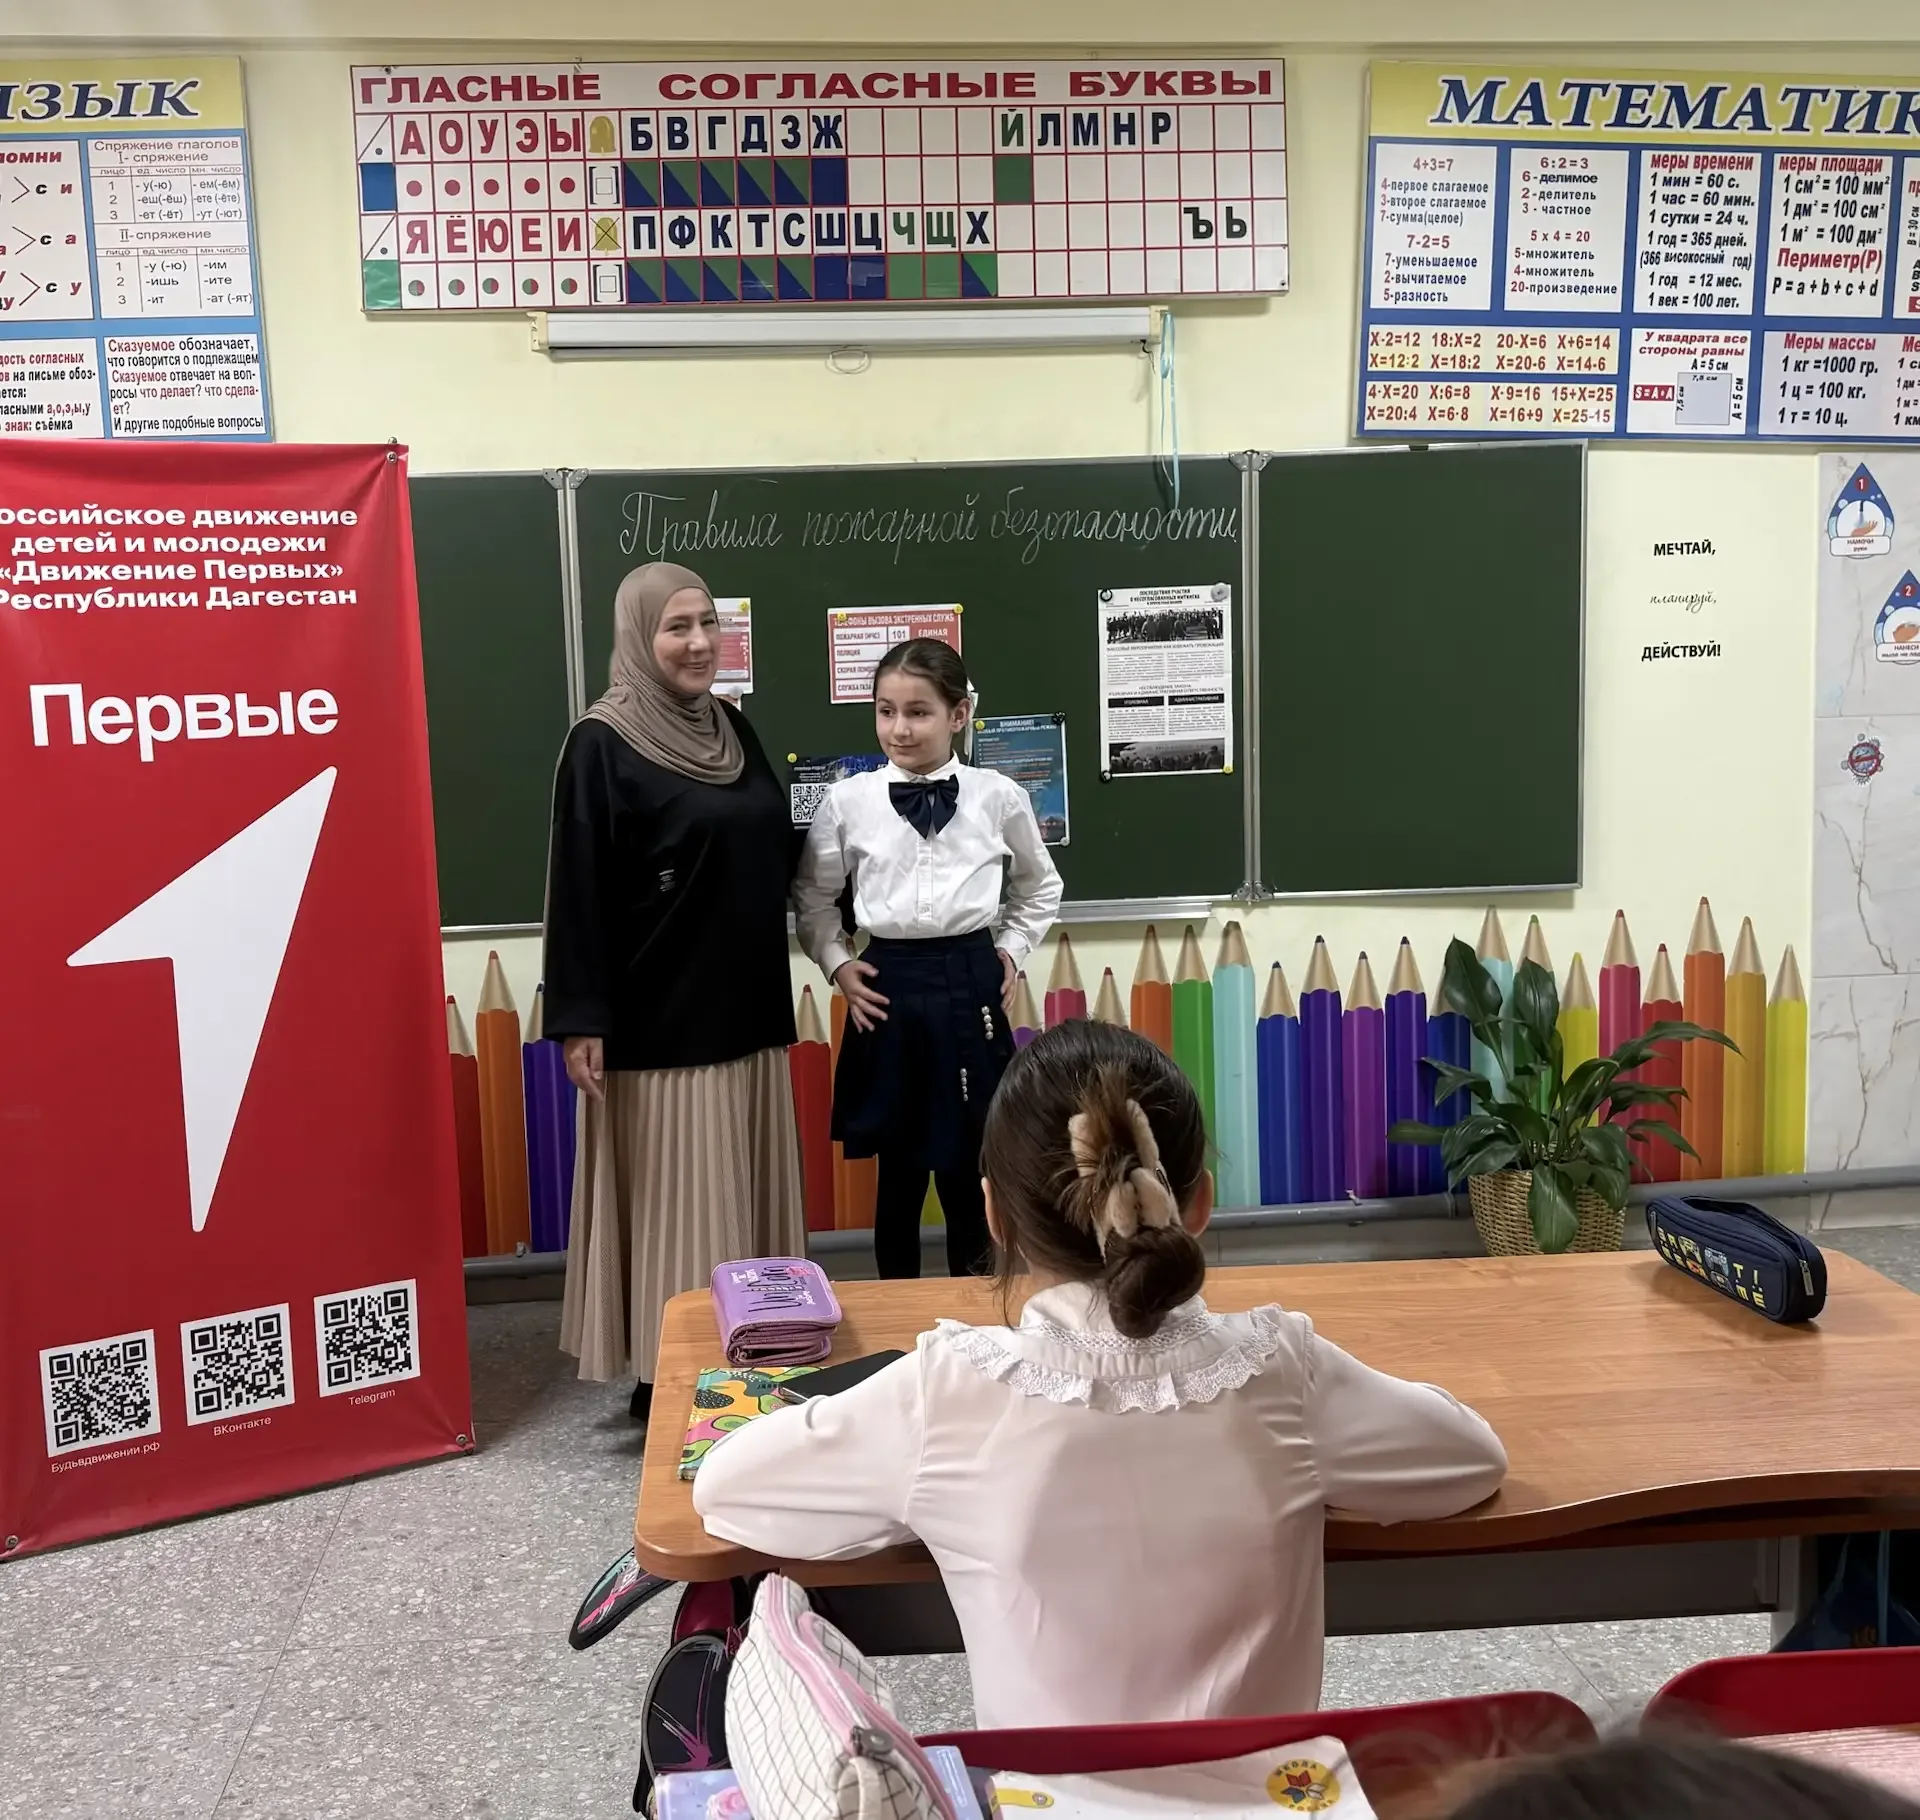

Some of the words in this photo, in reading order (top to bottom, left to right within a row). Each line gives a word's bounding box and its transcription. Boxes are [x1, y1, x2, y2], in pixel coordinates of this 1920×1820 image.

[360, 73, 600, 105] ГЛАСНЫЕ
[658, 72, 1037, 100] СОГЛАСНЫЕ
[1069, 70, 1273, 98] БУКВЫ
[400, 120, 426, 155] А
[438, 119, 463, 155] О
[479, 118, 499, 155] У
[516, 118, 539, 153] Э
[549, 117, 581, 153] Ы
[630, 117, 653, 151] Б
[667, 116, 690, 151] В
[707, 115, 727, 150] Г
[741, 115, 768, 153] Д
[780, 115, 801, 150] З
[812, 114, 843, 150] Ж
[1037, 112, 1061, 146] Л
[1072, 112, 1100, 146] М
[1113, 112, 1137, 146] Н
[1152, 111, 1172, 145] Р
[94, 141, 173, 153] Спряжение
[178, 140, 239, 150] глаголов
[133, 153, 209, 166] спряжение
[1413, 158, 1454, 172] 4+3=7
[1651, 154, 1688, 172] меры
[1693, 154, 1754, 173] времени
[1779, 155, 1816, 175] меры
[1820, 156, 1883, 174] площади
[1432, 181, 1489, 194] слагаемое
[1430, 197, 1487, 210] слагаемое
[1542, 205, 1592, 215] частное
[1660, 212, 1700, 228] сутки
[136, 231, 212, 242] спряжение
[406, 219, 428, 255] Я
[478, 218, 509, 252] Ю
[521, 218, 541, 252] Е
[558, 217, 581, 252] И
[633, 216, 656, 251] П
[668, 215, 696, 250] Ф
[711, 214, 732, 249] К
[748, 214, 769, 249] Т
[783, 213, 805, 248] С
[814, 212, 846, 247] Ш
[854, 212, 882, 251] Ц
[892, 211, 915, 246] Ч
[926, 211, 956, 248] Щ
[966, 211, 990, 245] Х
[1183, 207, 1214, 239] Ъ
[1226, 206, 1247, 239] Ь
[1407, 235, 1450, 249] 7-2=5
[1664, 250, 1725, 265] високосный
[108, 339, 175, 355] Сказуемое
[179, 337, 254, 351] обозначает,
[1658, 334, 1719, 345] квадрата
[1724, 335, 1748, 344] все
[1784, 333, 1824, 353] Меры
[1828, 337, 1876, 351] массы
[29, 353, 84, 364] согласных
[1639, 346, 1697, 357] стороны
[1701, 347, 1745, 358] равны
[107, 356, 125, 367] что
[128, 355, 180, 369] говорится
[184, 355, 190, 365] о
[193, 353, 259, 367] подлежащем
[13, 371, 26, 381] на
[28, 370, 66, 381] письме
[69, 366, 96, 380] обоз-
[112, 370, 167, 385] Сказуемое
[170, 370, 215, 382] отвечает
[219, 370, 230, 380] на
[234, 369, 256, 380] воп-
[110, 388, 137, 402] росы
[140, 388, 157, 398] что
[160, 384, 202, 400] делает?
[205, 386, 222, 397] что
[225, 385, 259, 399] сдела-
[113, 401, 130, 414] ет?
[5, 421, 32, 431] знак:
[35, 417, 73, 430] съёмка
[114, 417, 121, 430] И
[124, 418, 159, 434] другие
[162, 415, 215, 430] подобные
[218, 416, 264, 430] вопросы
[192, 507, 358, 528] движение
[620, 489, 783, 564] Правила
[802, 493, 980, 564] пожарной
[11, 532, 117, 557] детей
[124, 535, 145, 553] и
[153, 535, 327, 555] молодежи
[1653, 539, 1716, 556] МЕЧТАЙ,
[203, 559, 344, 584] Первых»
[206, 586, 357, 610] Дагестан
[892, 630, 906, 639] 101
[918, 628, 948, 637] ЕДИНАЯ
[1642, 640, 1721, 661] ДЕЙСТВУЙ!
[29, 683, 340, 763] Первые
[348, 1387, 396, 1406] Telegram
[213, 1416, 272, 1437] ВКонтакте
[51, 1441, 161, 1474] Будьвдвижении.рф
